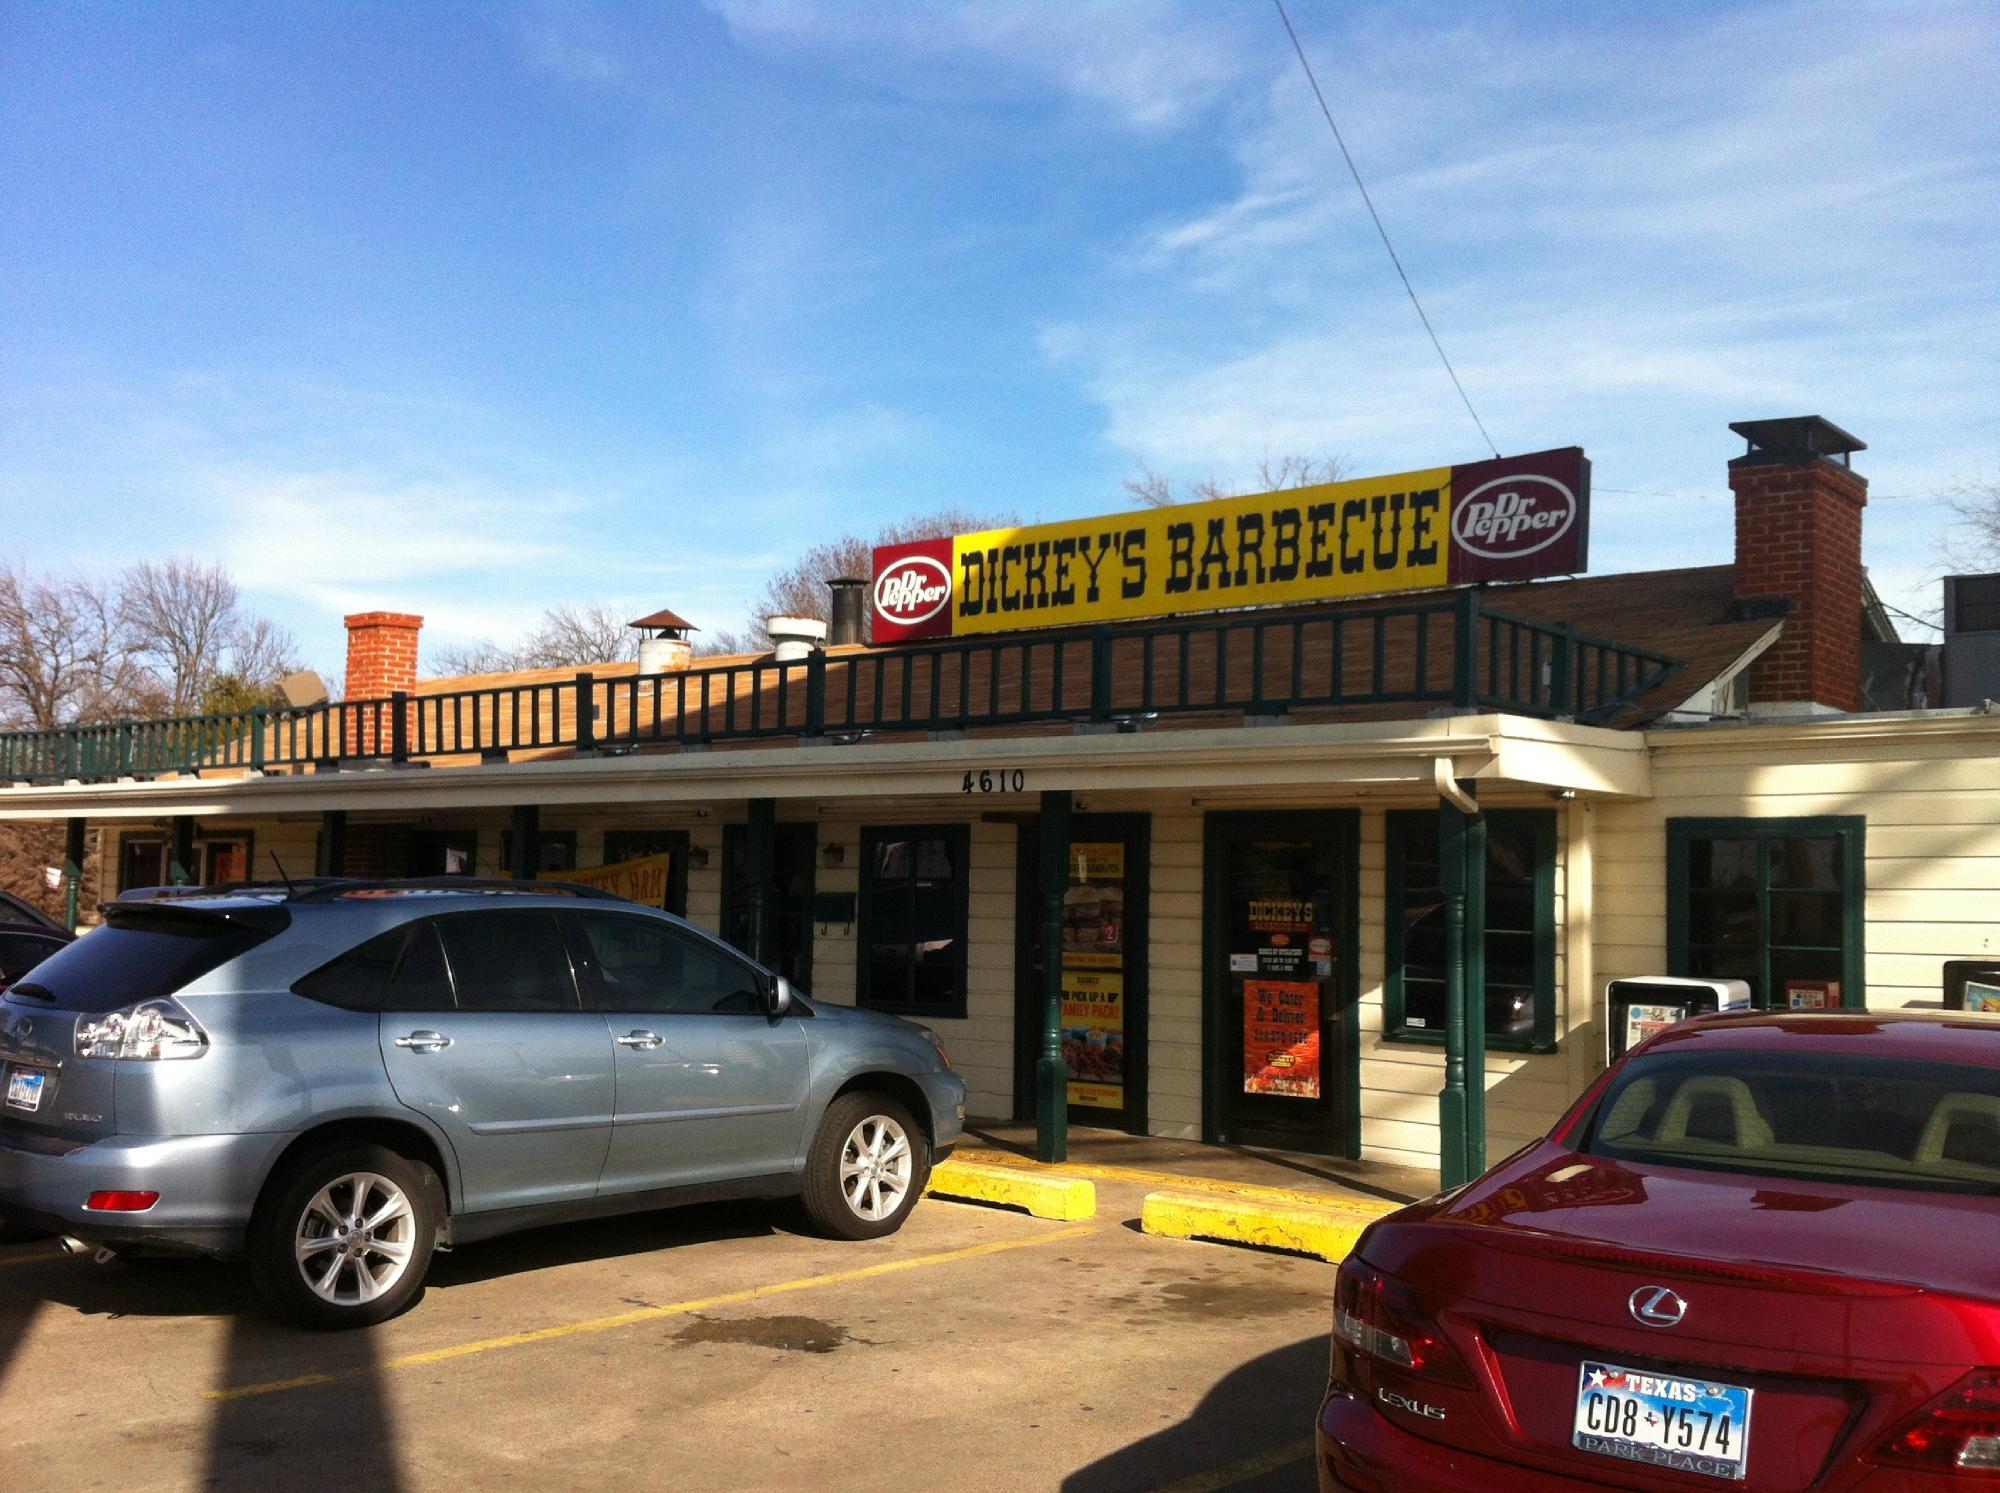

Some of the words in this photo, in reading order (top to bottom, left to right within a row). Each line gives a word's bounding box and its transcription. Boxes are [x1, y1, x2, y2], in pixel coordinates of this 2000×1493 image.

[1462, 502, 1567, 544] Pepper
[959, 528, 1147, 617] DICKEY'S
[1165, 488, 1440, 594] BARBECUE
[881, 578, 946, 612] Pepper
[962, 769, 1024, 793] 4610
[1063, 1002, 1089, 1016] AMILY
[1379, 1388, 1446, 1420] LEXUS
[1625, 1373, 1697, 1402] TEXAS
[1586, 1393, 1638, 1437] CD8
[1662, 1405, 1731, 1455] Y574
[1585, 1437, 1646, 1459] PARK
[1654, 1452, 1730, 1476] PLACE
